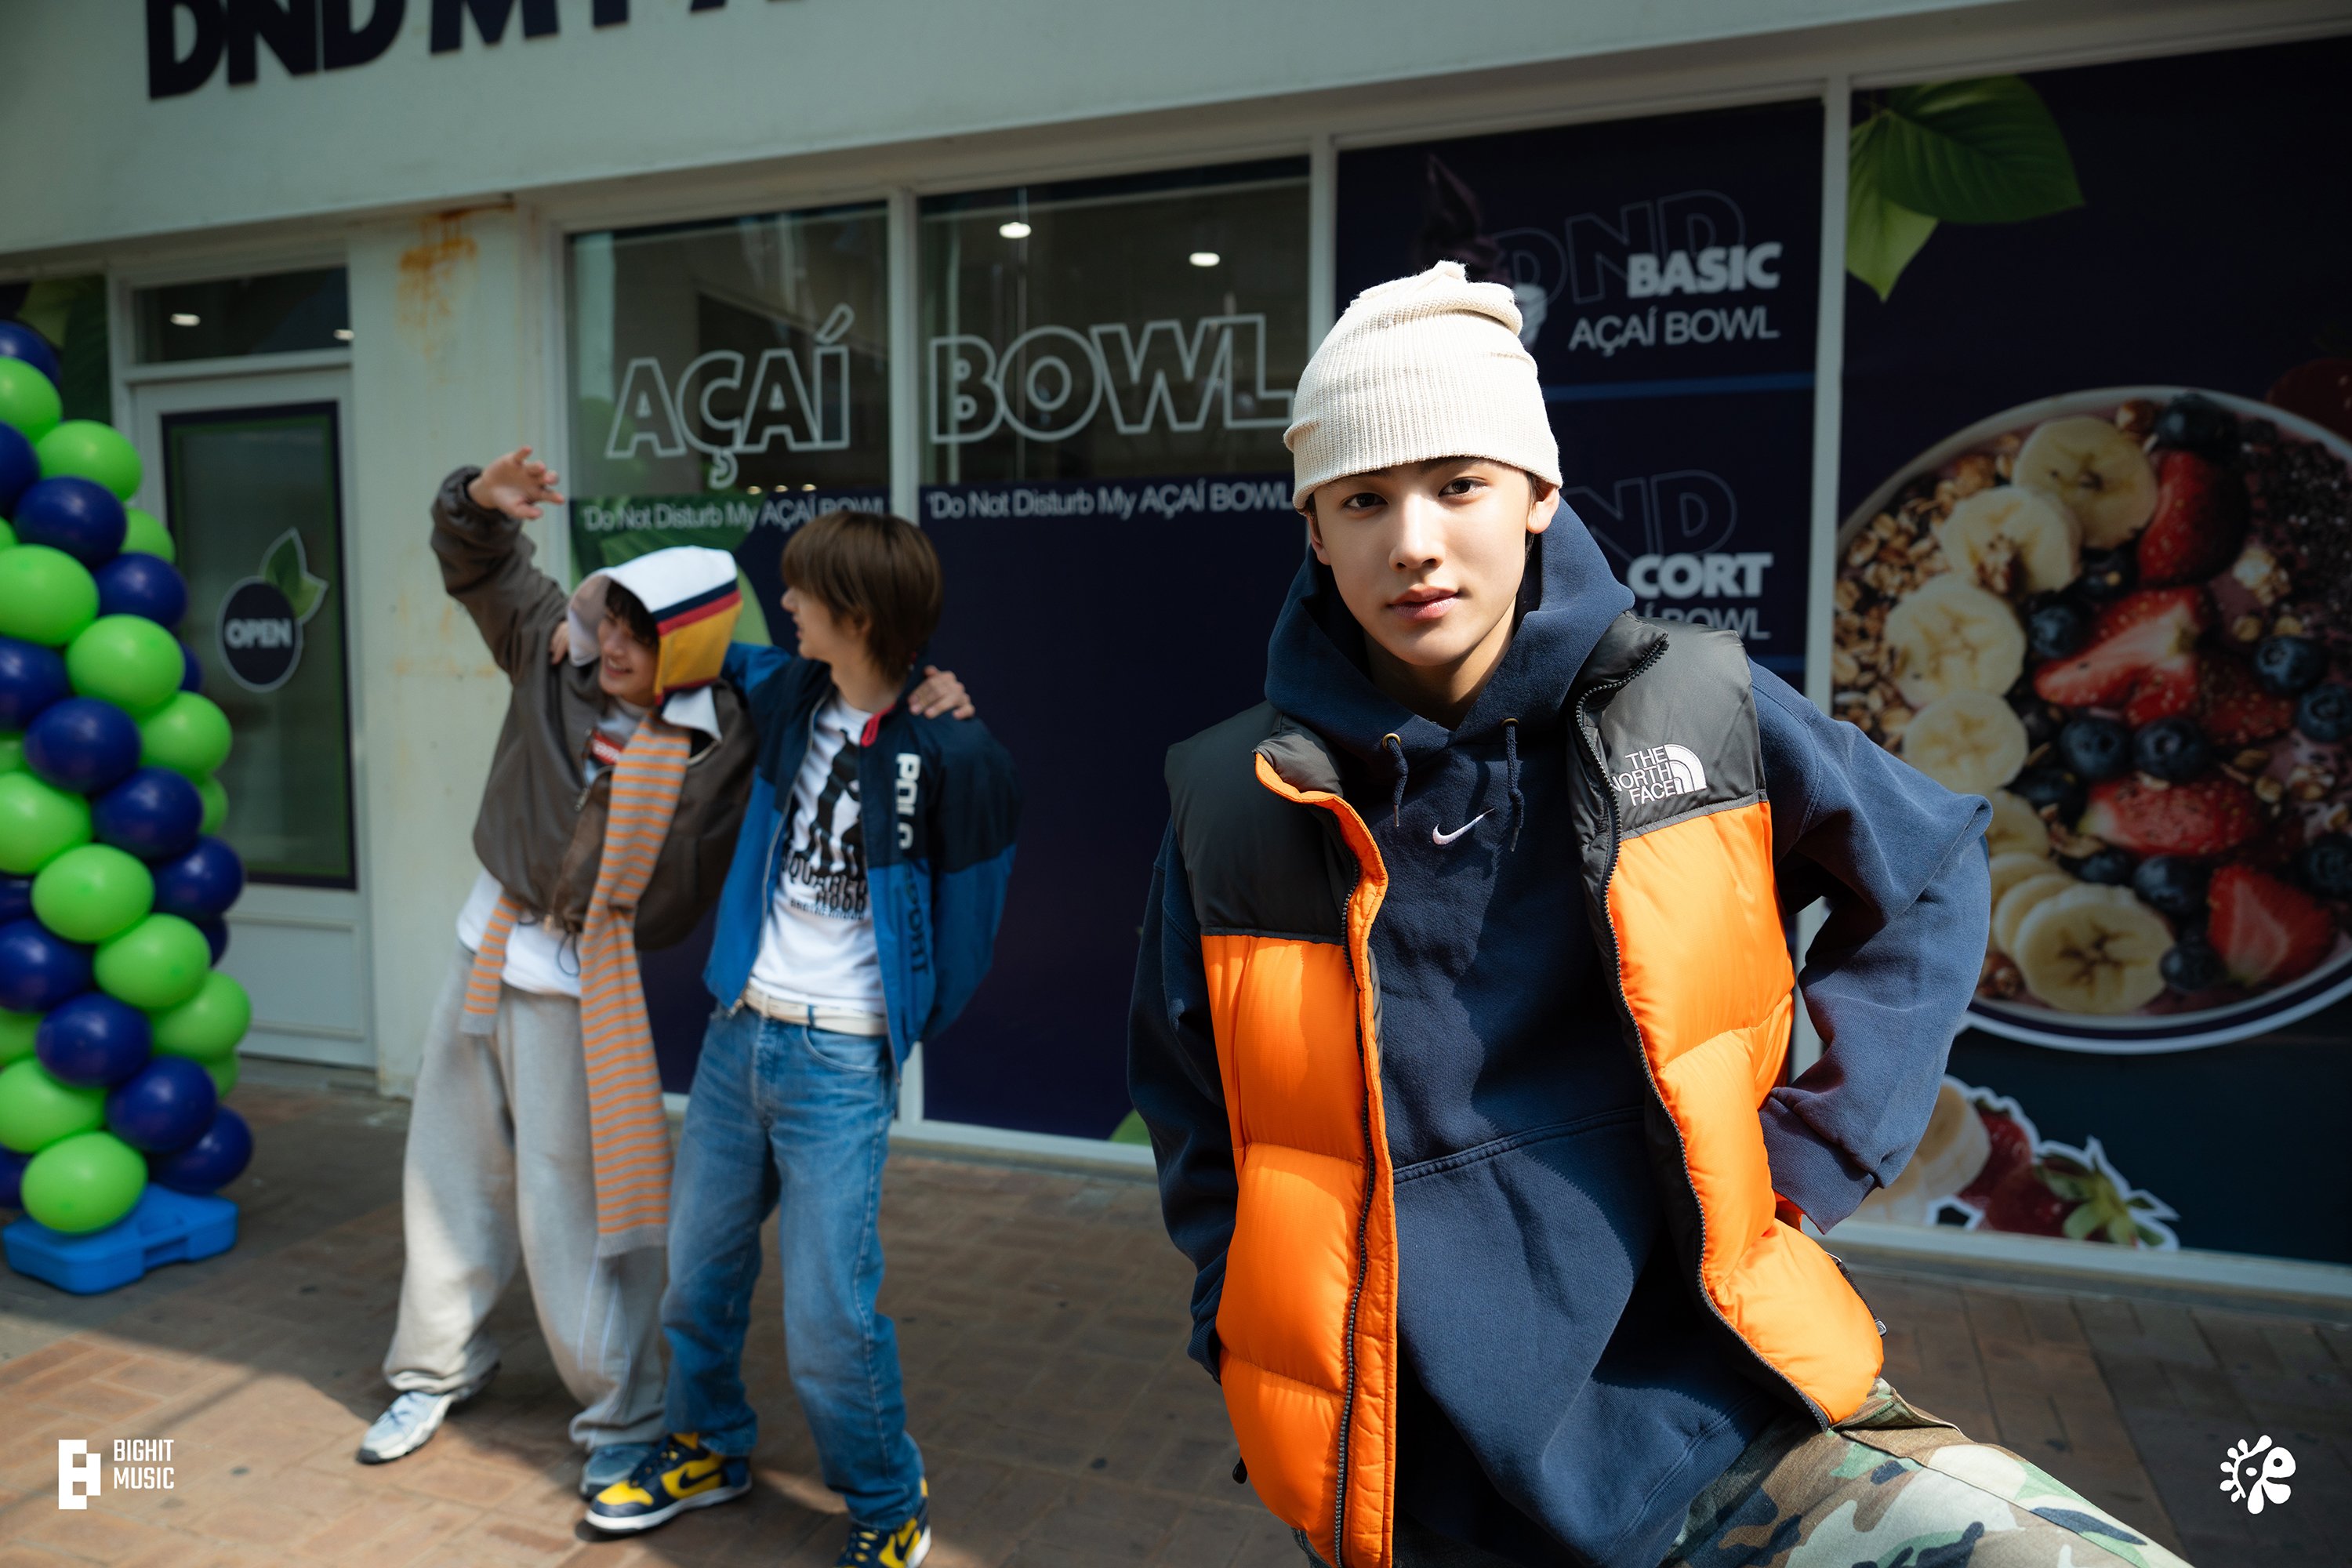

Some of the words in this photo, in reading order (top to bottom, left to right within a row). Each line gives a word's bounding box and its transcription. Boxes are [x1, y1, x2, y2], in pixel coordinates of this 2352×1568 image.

[146, 0, 405, 100] DND
[1627, 241, 1783, 299] BASIC
[1568, 306, 1657, 357] AÇAÍ
[1664, 305, 1781, 345] BOWL
[605, 303, 850, 489] AÇAÍ
[929, 313, 1295, 445] BOWL
[615, 503, 653, 530] Not
[654, 502, 724, 528] Disturb
[724, 500, 759, 533] My
[967, 490, 1011, 517] Not
[1012, 487, 1095, 517] Disturb
[1098, 485, 1137, 521] My
[1139, 477, 1205, 520] AÇAÍ
[1209, 481, 1294, 512] BOWL
[1562, 470, 1737, 555] ND
[1627, 552, 1775, 600] CORT
[224, 618, 293, 649] OPEN
[1610, 761, 1672, 793] NORTH
[1625, 746, 1668, 770] THE
[1629, 779, 1676, 807] FACE
